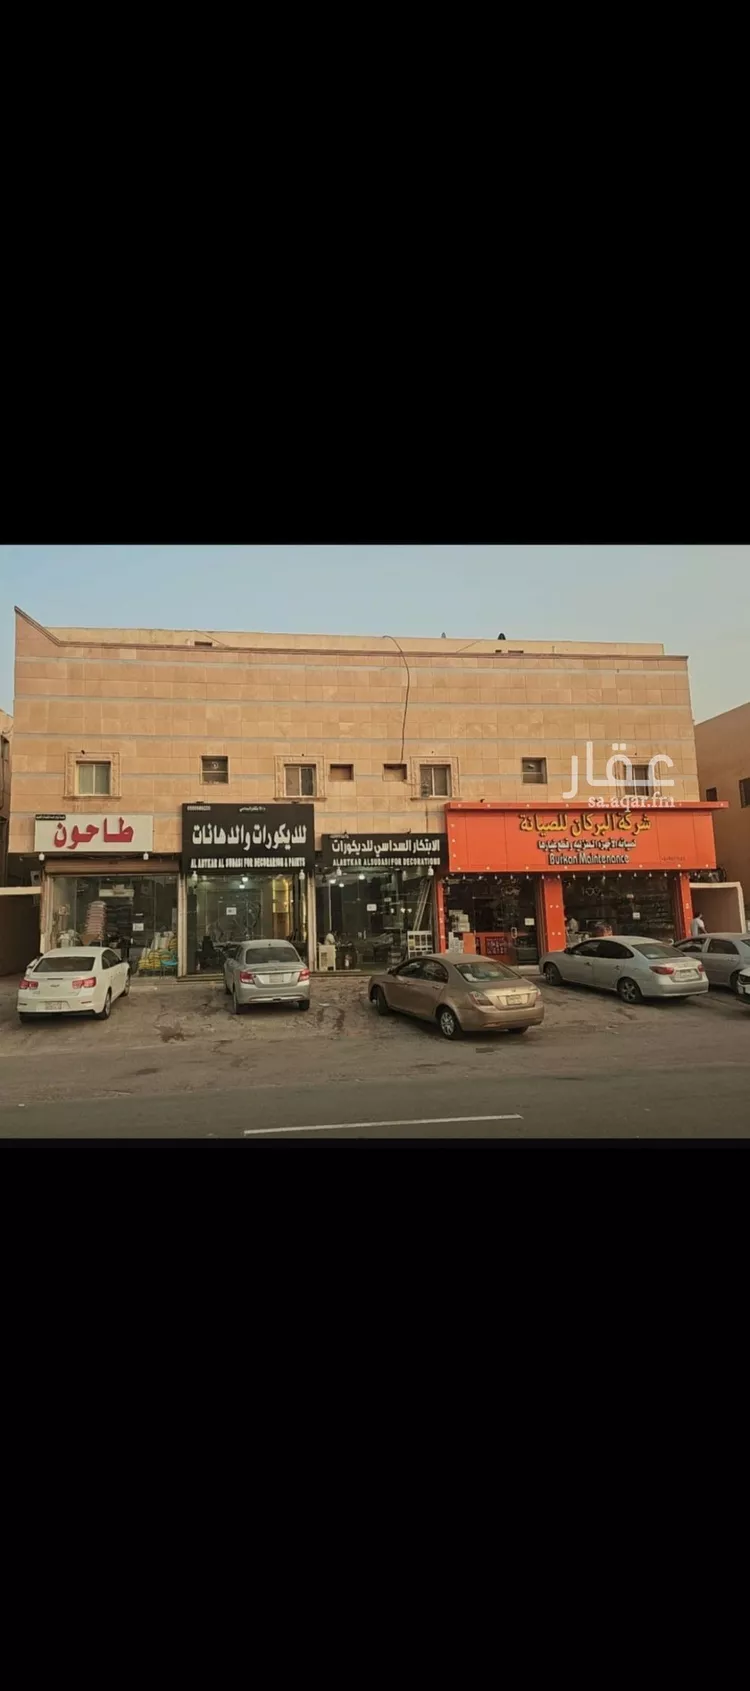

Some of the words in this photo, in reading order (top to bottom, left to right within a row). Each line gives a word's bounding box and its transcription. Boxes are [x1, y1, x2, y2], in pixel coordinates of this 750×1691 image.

[54, 816, 134, 850] طاحون
[519, 813, 568, 837] للصيانة
[571, 813, 615, 837] البركان
[617, 812, 651, 835] شركة
[192, 823, 251, 851] والدهانات
[252, 823, 307, 850] للديكورات
[413, 838, 440, 855] الابتكار
[332, 839, 373, 855] للديكورات
[374, 839, 412, 857] السداسي
[243, 857, 253, 868] FOR
[391, 857, 402, 866] FOR
[548, 852, 578, 866] Burkan
[579, 851, 630, 864] Maintenance
